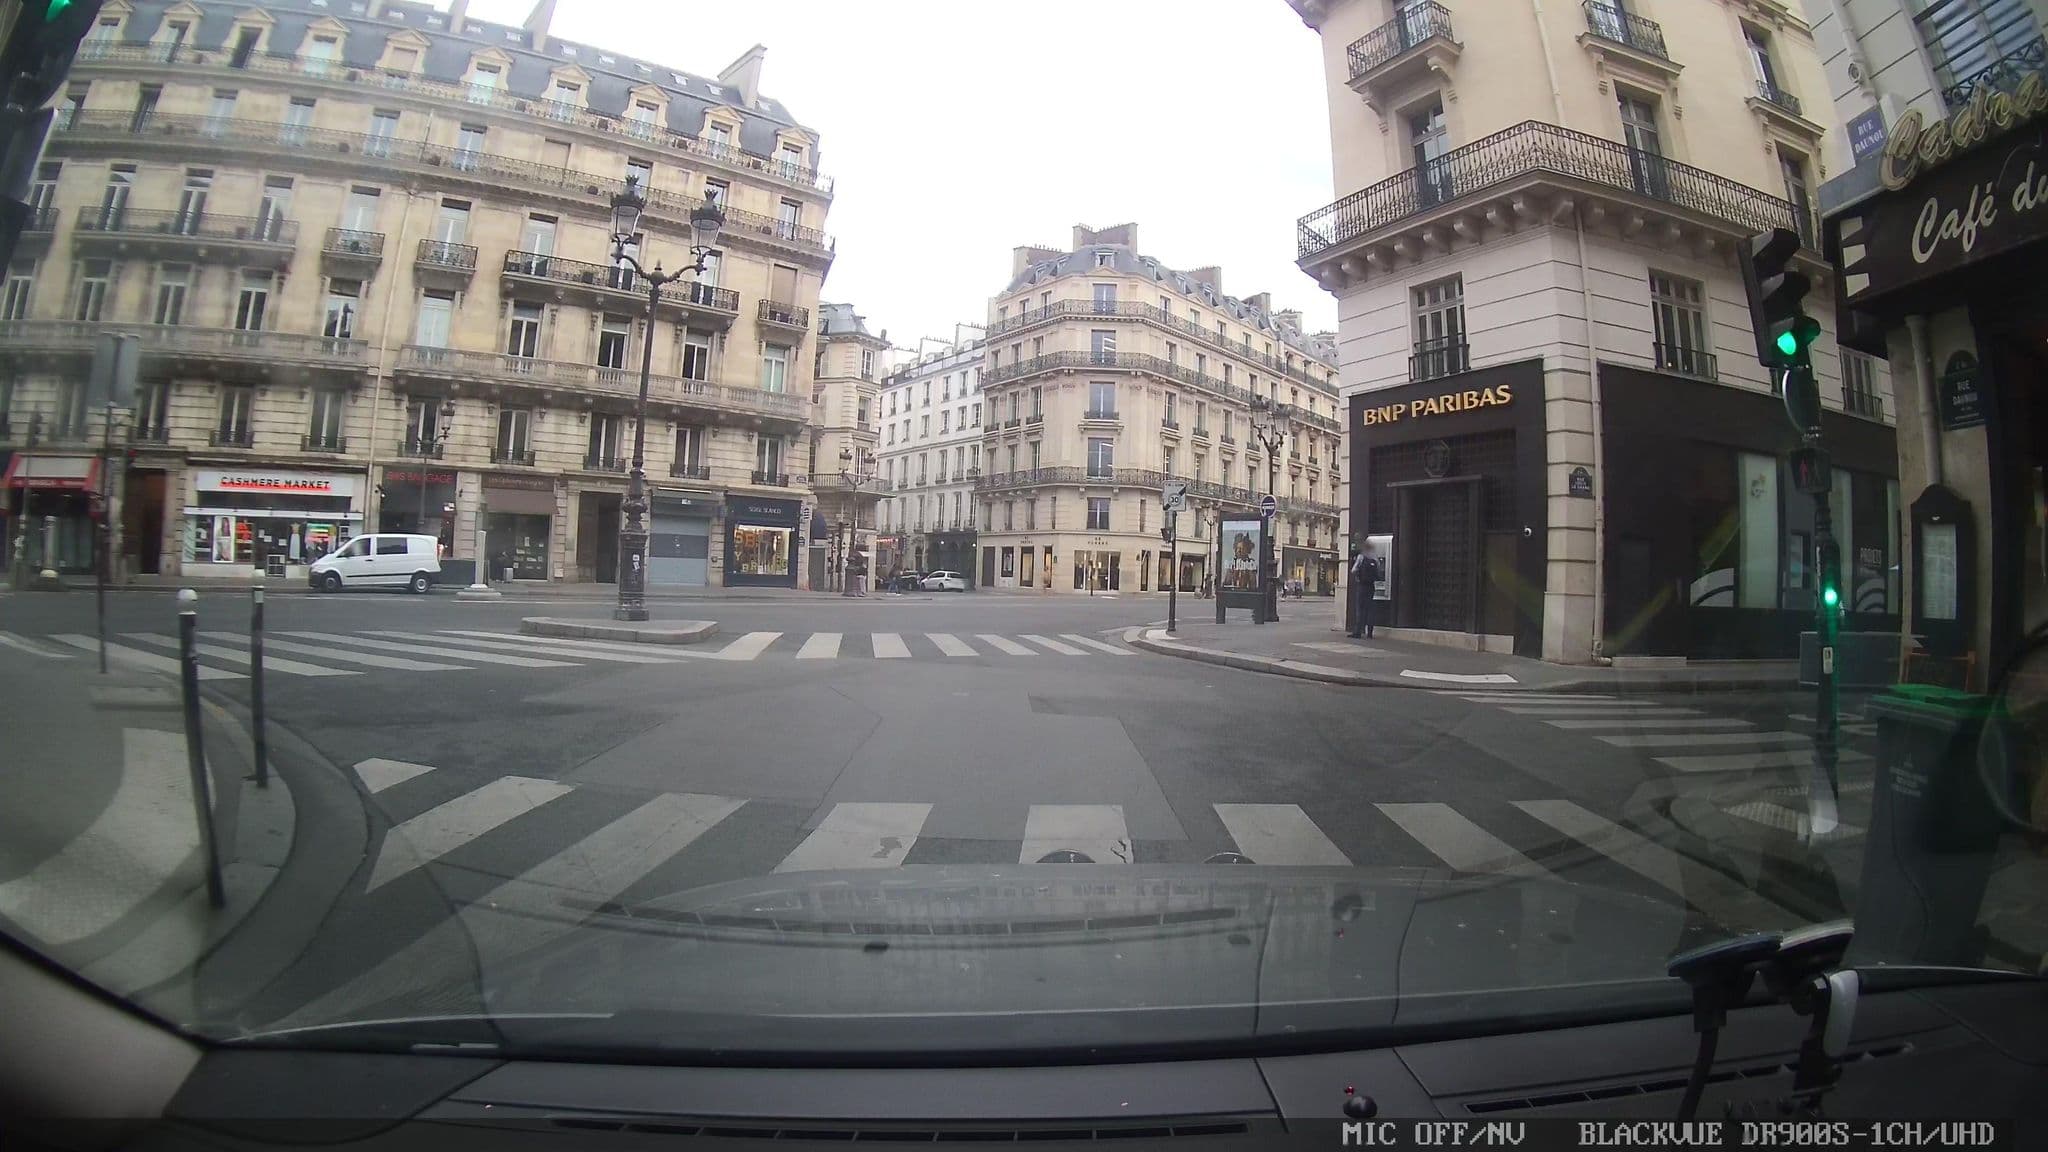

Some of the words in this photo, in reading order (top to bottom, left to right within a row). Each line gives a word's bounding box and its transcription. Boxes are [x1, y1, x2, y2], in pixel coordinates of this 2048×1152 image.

[1858, 119, 1874, 136] RUE
[1912, 181, 1998, 263] Café
[1363, 403, 1407, 426] BNP
[1411, 384, 1514, 418] PARIBAS
[221, 476, 281, 488] CASHMERE
[284, 480, 331, 490] MARKET
